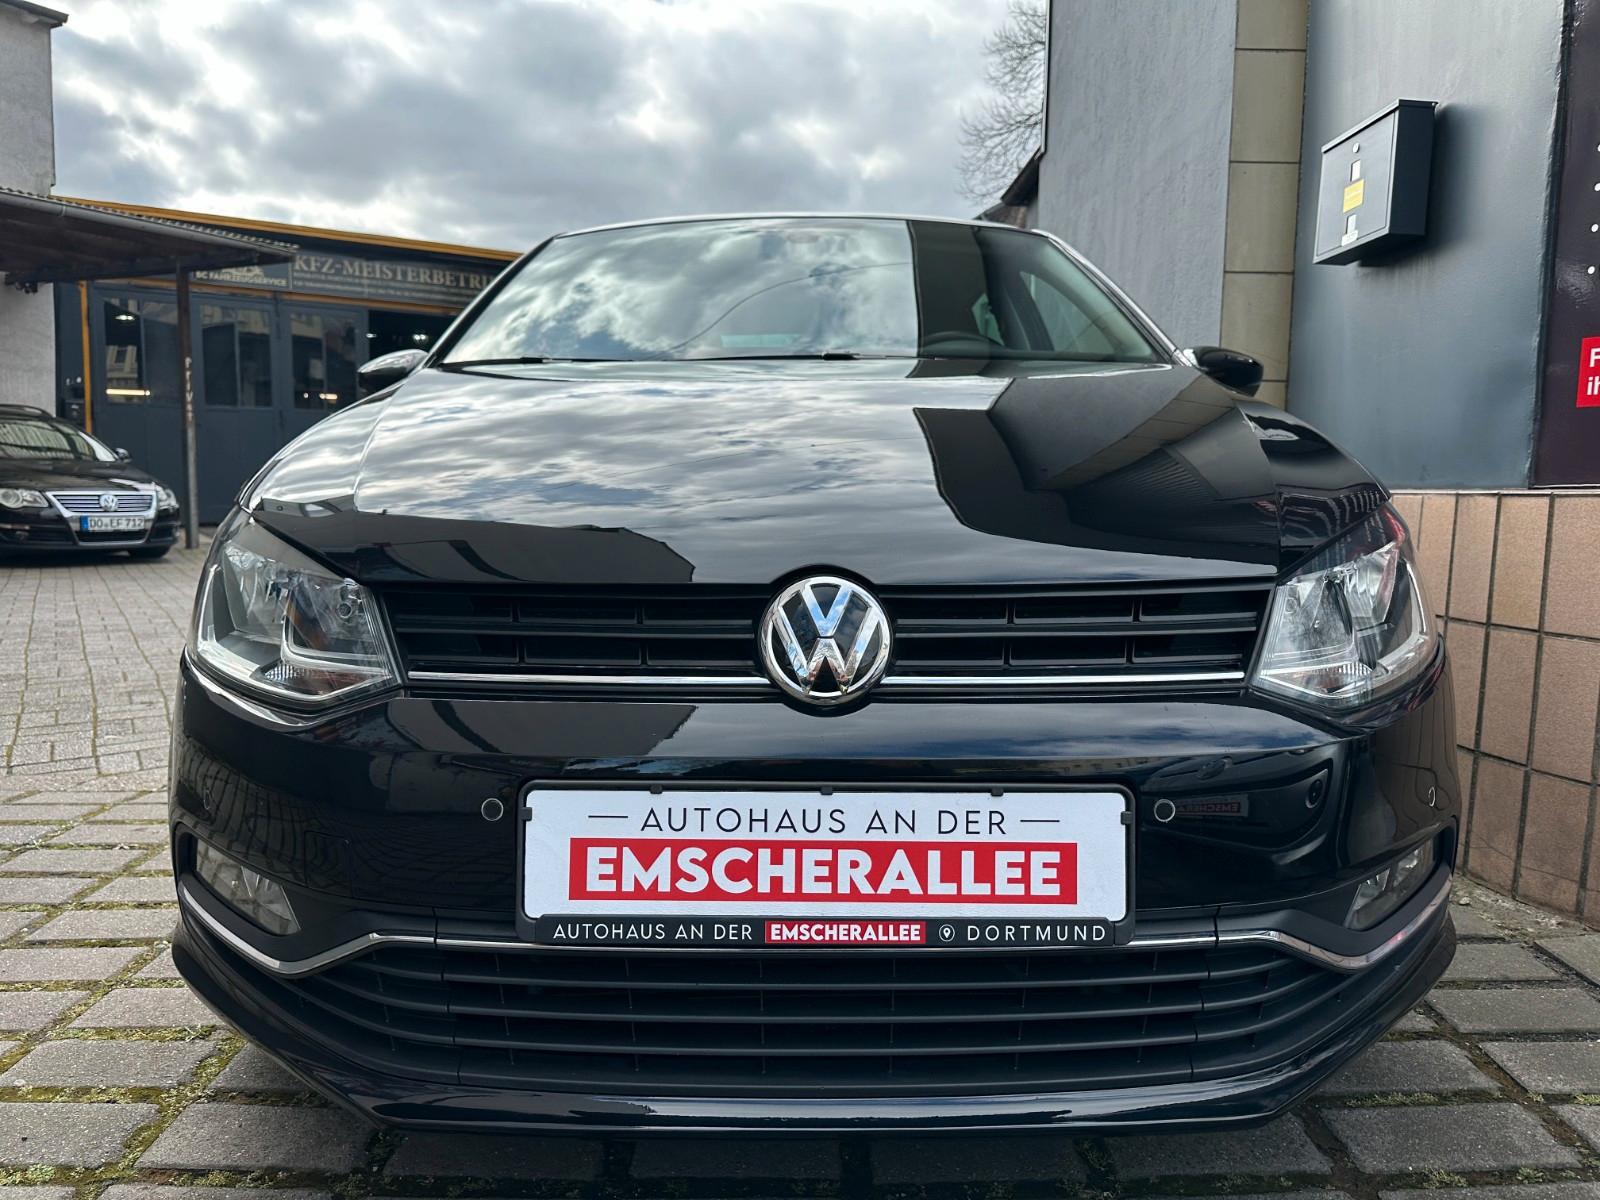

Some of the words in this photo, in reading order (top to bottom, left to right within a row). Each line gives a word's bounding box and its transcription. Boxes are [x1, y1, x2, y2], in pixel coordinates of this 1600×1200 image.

[641, 807, 846, 835] AUTOHAUS
[865, 808, 916, 835] AN
[938, 810, 1007, 835] DER
[586, 846, 1061, 896] EMSCHERALLEE
[552, 923, 666, 941] AUTOHAUS
[675, 923, 703, 941] AN
[714, 923, 753, 941] DER
[770, 923, 921, 942] EMSCHERALLEE
[967, 924, 1106, 942] DORTMUND
